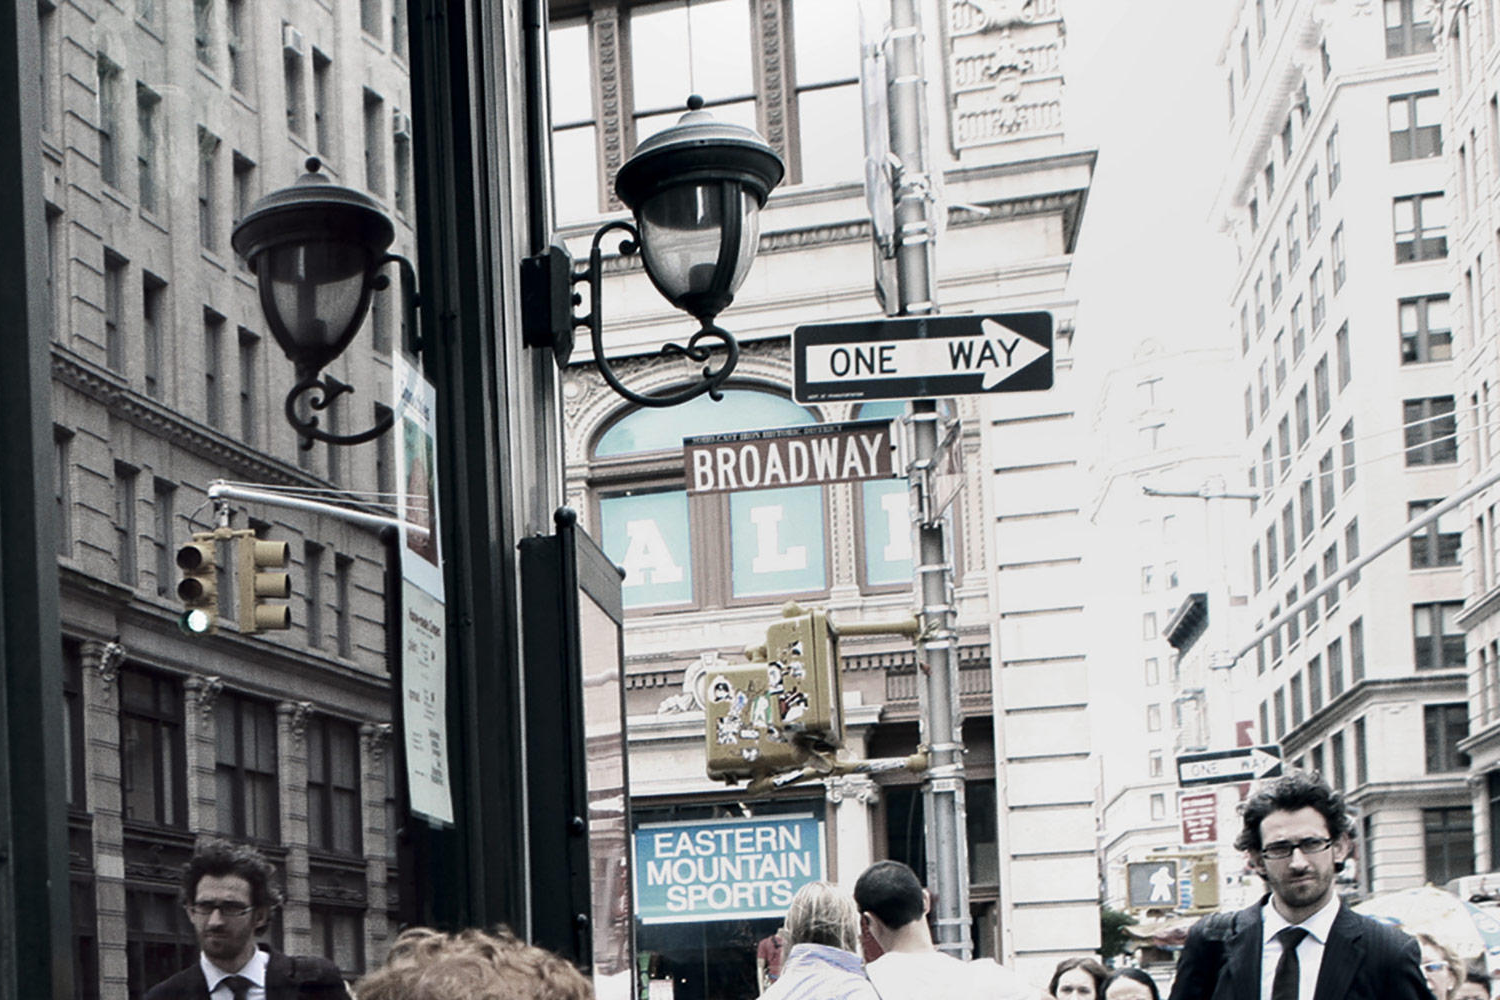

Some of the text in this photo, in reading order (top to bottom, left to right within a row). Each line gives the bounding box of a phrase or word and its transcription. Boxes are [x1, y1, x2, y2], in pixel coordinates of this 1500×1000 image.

[830, 338, 1021, 377] ONE WAY
[693, 432, 884, 492] BROADWAY
[1191, 757, 1268, 777] ONE WAY
[654, 824, 801, 858] EASTERN
[646, 851, 812, 886] MOUNTAIN
[666, 880, 794, 912] SPORTS
